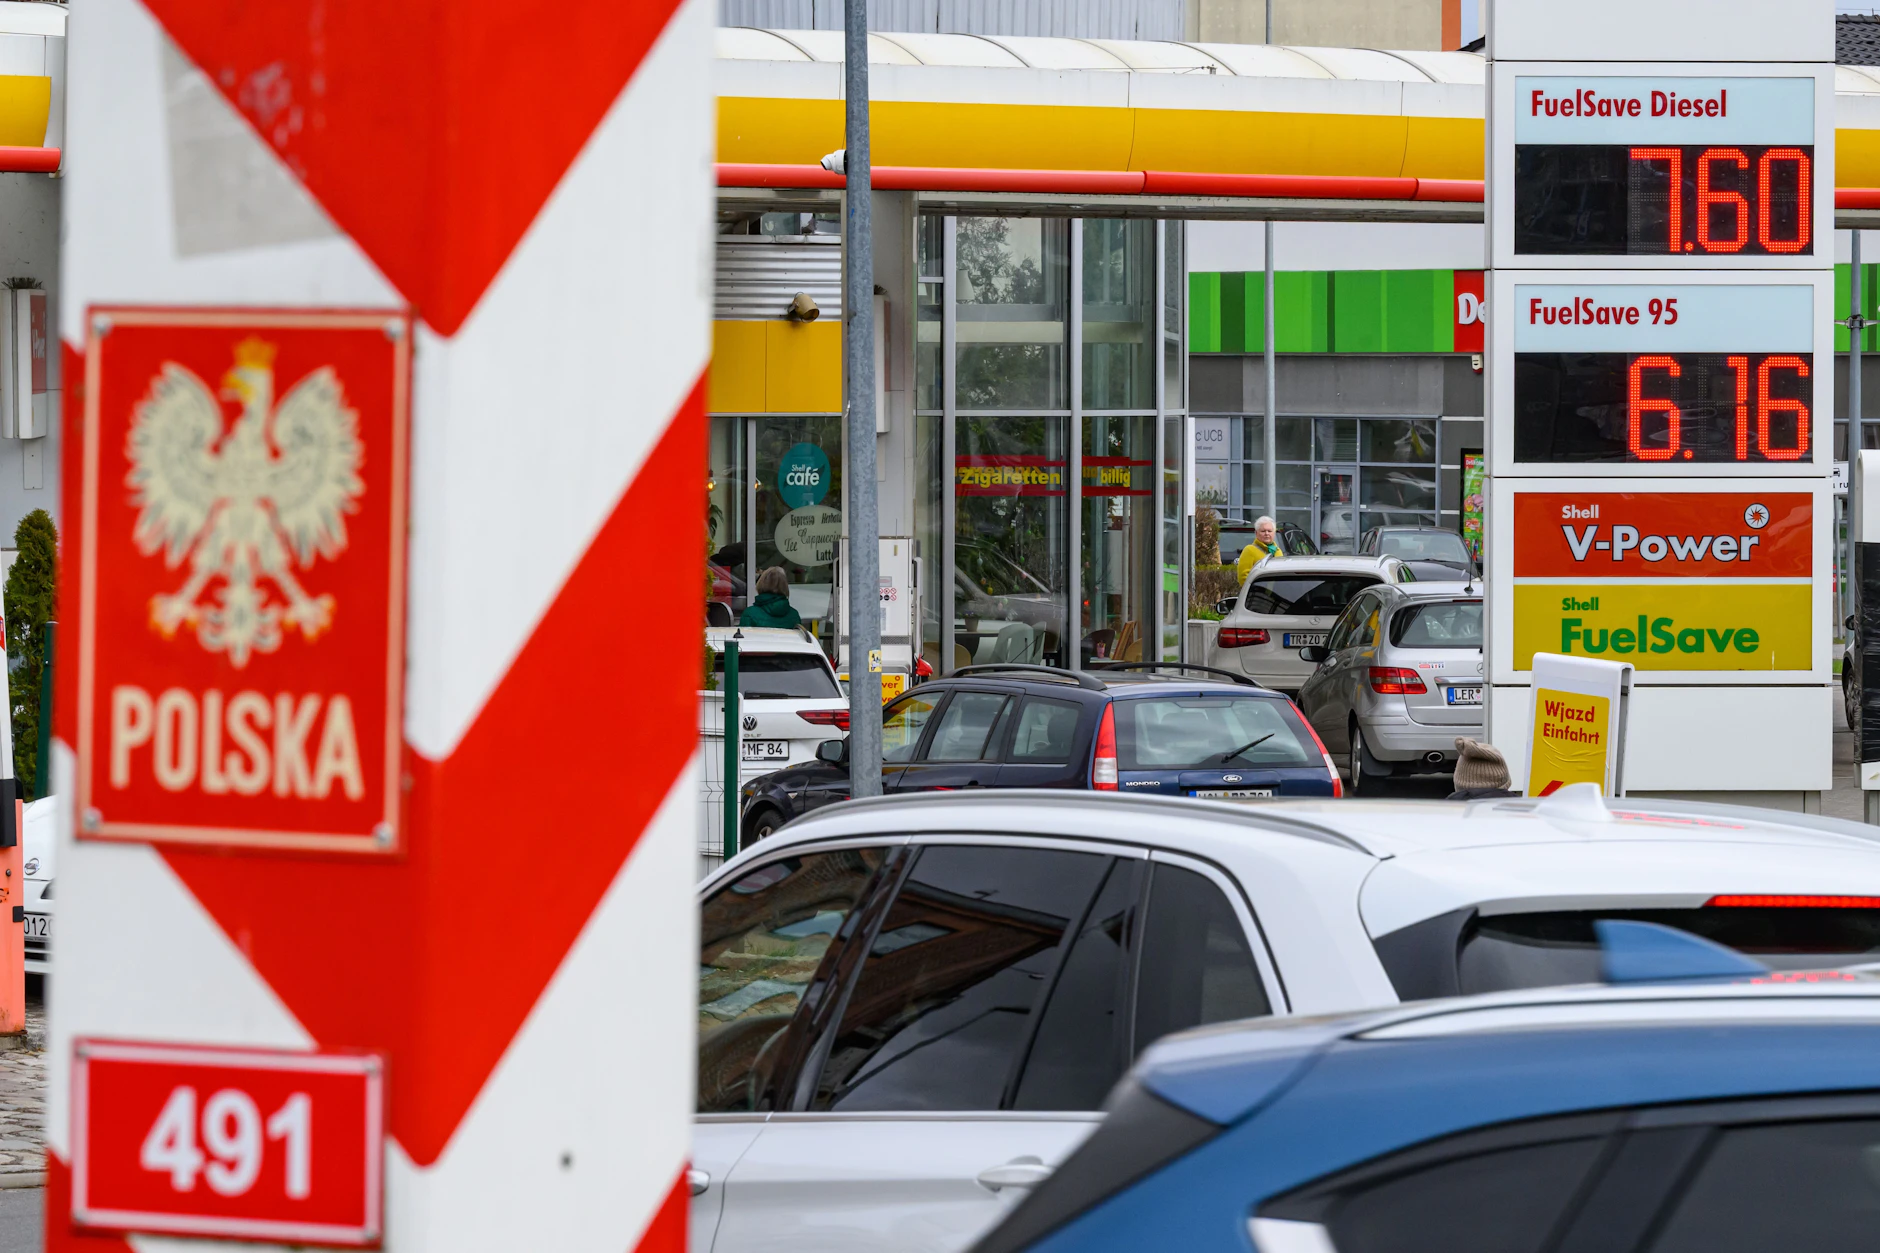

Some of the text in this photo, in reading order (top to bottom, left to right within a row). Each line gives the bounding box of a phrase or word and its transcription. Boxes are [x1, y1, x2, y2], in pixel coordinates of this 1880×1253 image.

[1531, 89, 1727, 118] FuelSave Diesel
[1629, 147, 1811, 254] 7.60
[1529, 297, 1679, 326] FuelSave 95
[1629, 356, 1810, 461] 6.16
[1203, 429, 1223, 442] UCB
[786, 467, 820, 486] café
[791, 464, 806, 472] Shell
[960, 468, 1061, 488] Zigaretten
[1100, 467, 1131, 488] billig
[790, 514, 815, 528] Espresso
[1561, 504, 1600, 519] Shell
[1561, 524, 1760, 562] V-Power
[1561, 596, 1600, 611] Shell
[1290, 634, 1302, 645] TR
[1560, 614, 1760, 655] FuelSave
[1454, 689, 1475, 700] LER
[1544, 699, 1596, 725] Wjazd
[110, 685, 365, 801] POLSKA
[1542, 721, 1600, 745] Einfahrt
[747, 742, 783, 756] MF 84
[140, 1085, 313, 1200] 491
